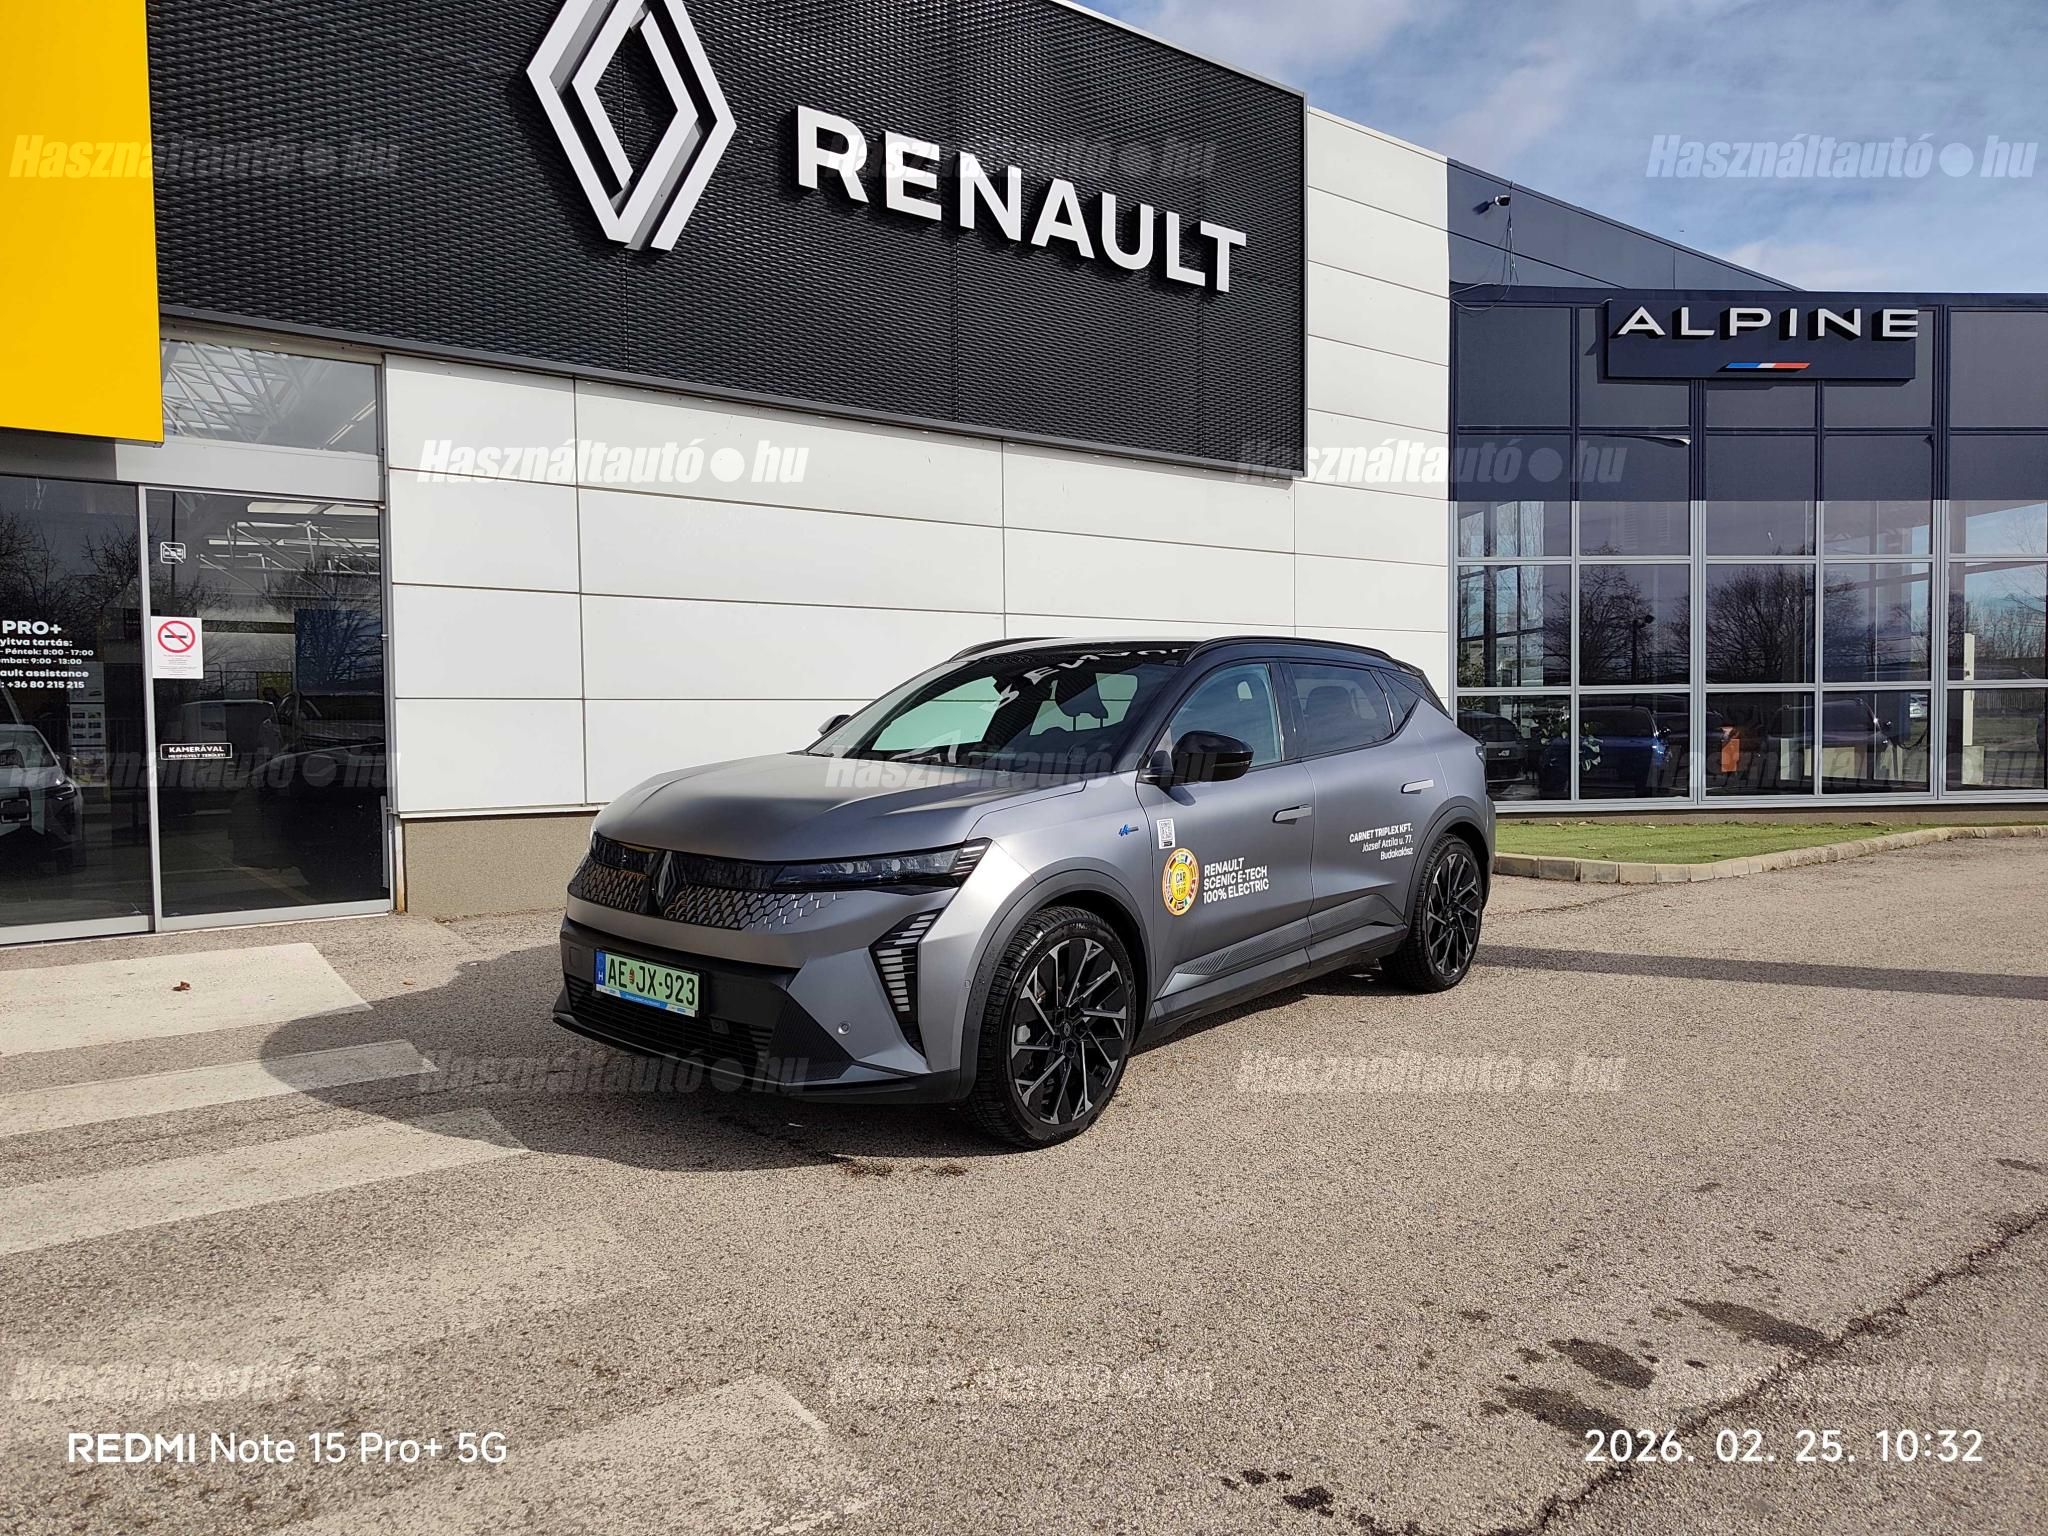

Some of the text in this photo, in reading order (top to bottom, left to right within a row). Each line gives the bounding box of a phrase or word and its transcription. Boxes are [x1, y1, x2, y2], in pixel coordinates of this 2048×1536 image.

[798, 104, 1247, 293] RENAULT
[1617, 306, 1919, 338] ALPINE
[2, 620, 62, 635] PRO+
[32, 638, 73, 647] tartás:
[5, 647, 42, 656] Péntek:
[0, 656, 29, 664] mbat:
[30, 657, 52, 665] 9:00
[25, 668, 89, 678] assistance
[7, 681, 28, 689] +36
[29, 680, 45, 689] 80
[46, 681, 65, 689] 215
[66, 681, 85, 689] 215
[168, 745, 225, 753] KAMERÁVAL
[1349, 829, 1375, 843] CARNET
[1204, 857, 1245, 878] RENAULT
[1203, 865, 1268, 891] SCENIC E-TECH
[1203, 878, 1270, 904] 100% ELECTRIC
[598, 971, 604, 981] H
[608, 958, 627, 989] AE
